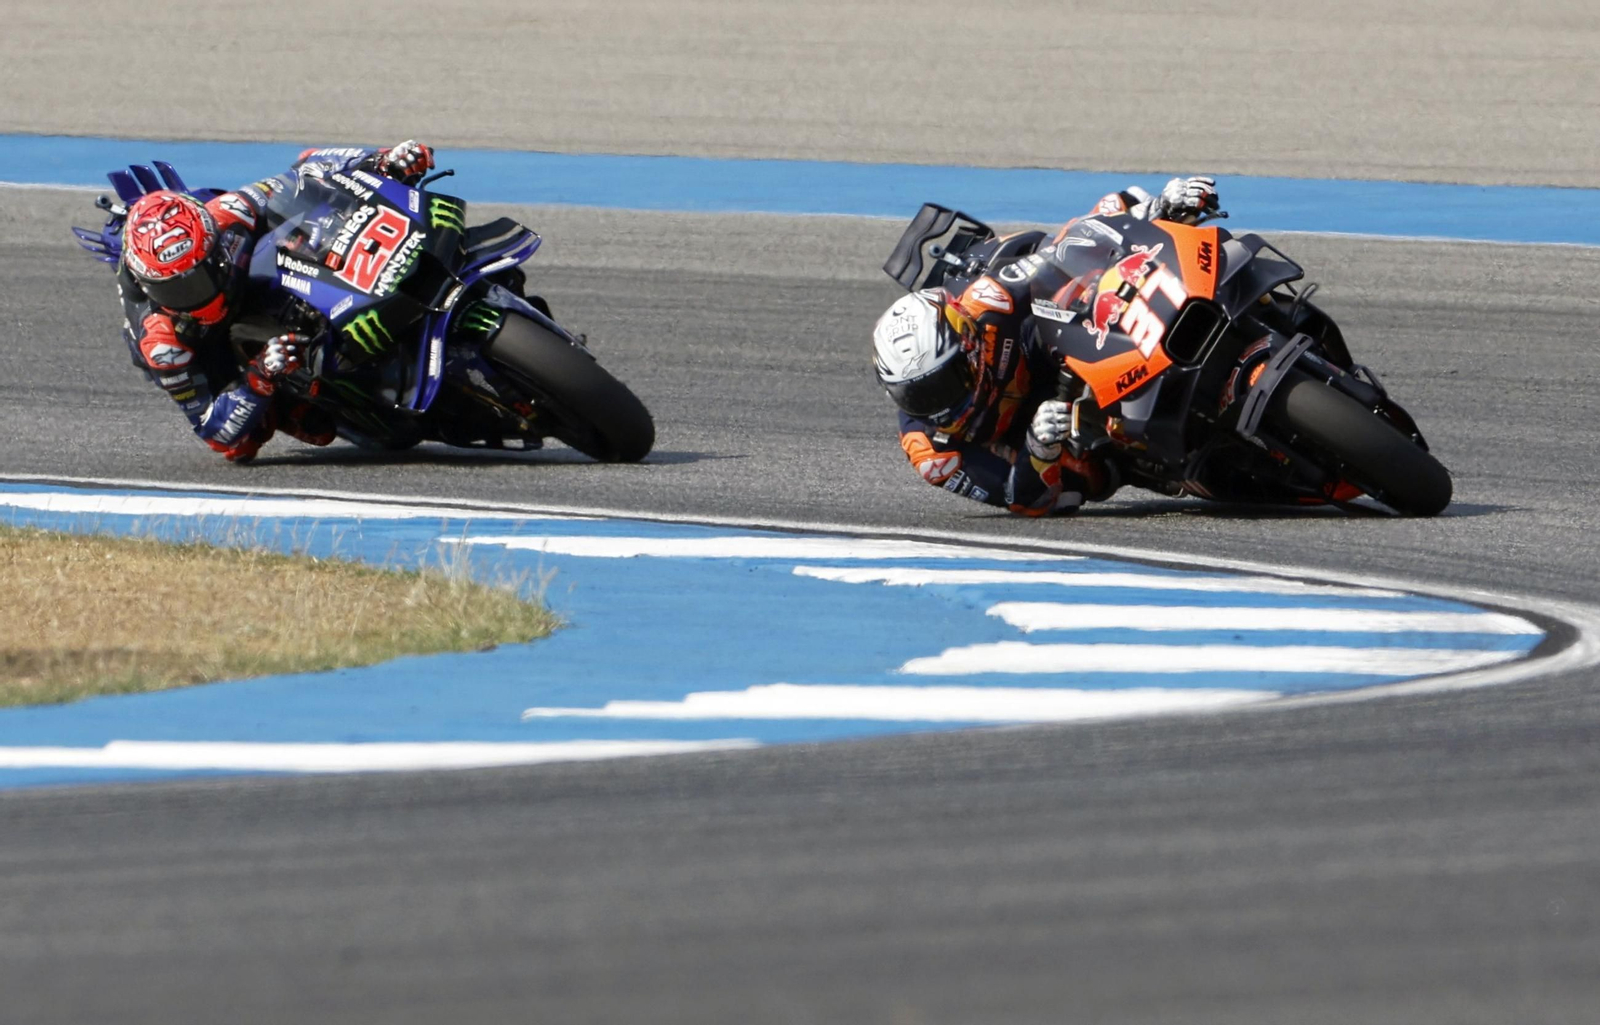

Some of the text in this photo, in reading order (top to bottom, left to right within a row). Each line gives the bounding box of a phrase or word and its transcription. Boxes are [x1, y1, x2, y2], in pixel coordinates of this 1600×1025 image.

[163, 241, 189, 259] HJC
[332, 204, 376, 255] ENEOS
[333, 204, 411, 294] 20
[284, 257, 319, 278] Roboze
[374, 230, 426, 297] MONSTER
[388, 244, 424, 293] ENERGY
[1197, 241, 1212, 274] KTM
[281, 273, 311, 295] YAMAHA
[1120, 265, 1189, 360] 37
[1115, 365, 1149, 394] KTM
[212, 398, 257, 443] YAMAHA
